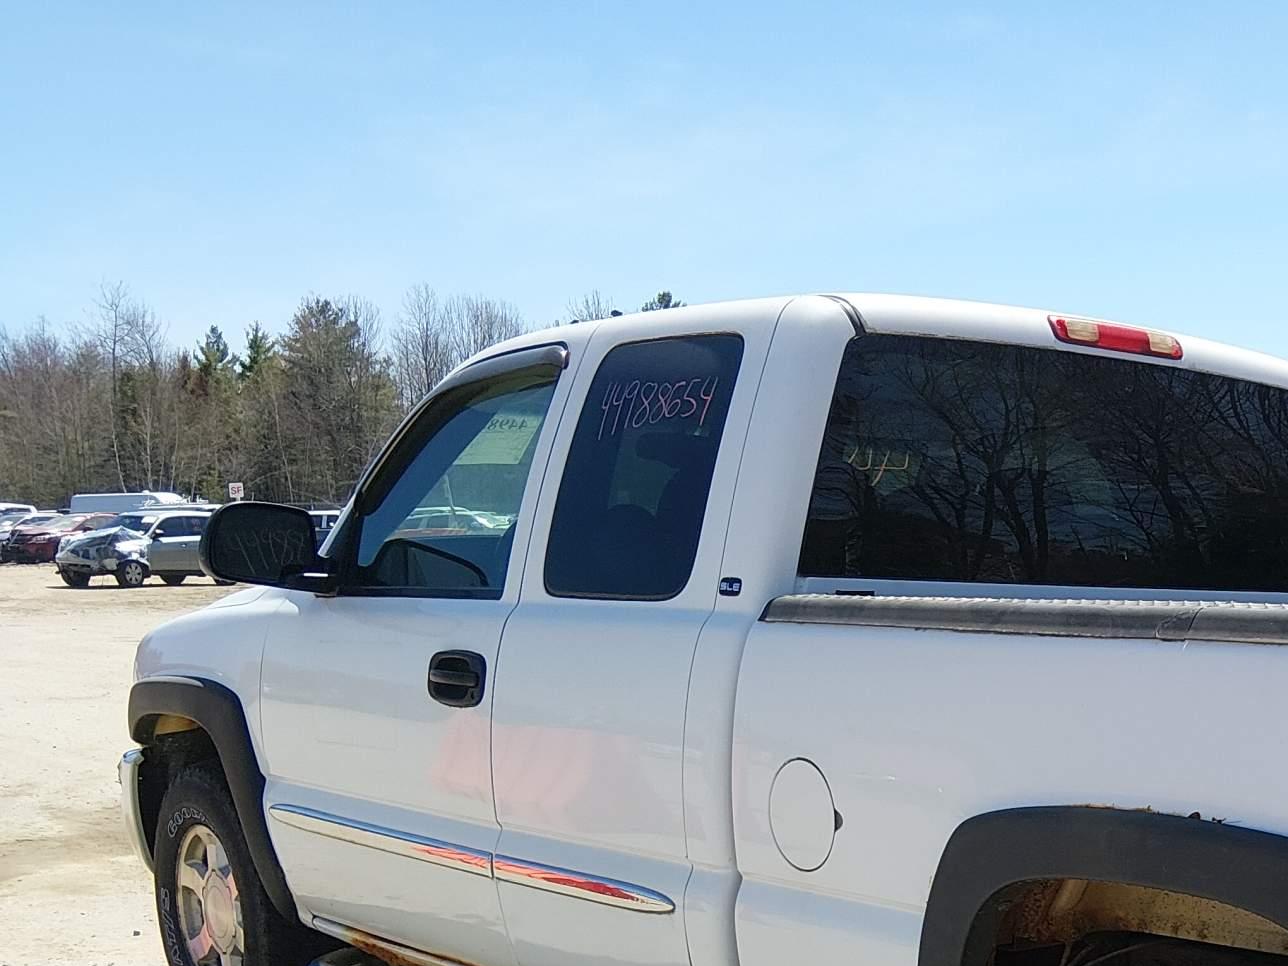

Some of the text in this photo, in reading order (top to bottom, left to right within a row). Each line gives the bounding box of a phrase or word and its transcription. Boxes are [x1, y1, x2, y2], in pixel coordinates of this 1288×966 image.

[598, 376, 719, 440] 44988654
[230, 486, 243, 495] SF
[720, 582, 740, 591] SLE
